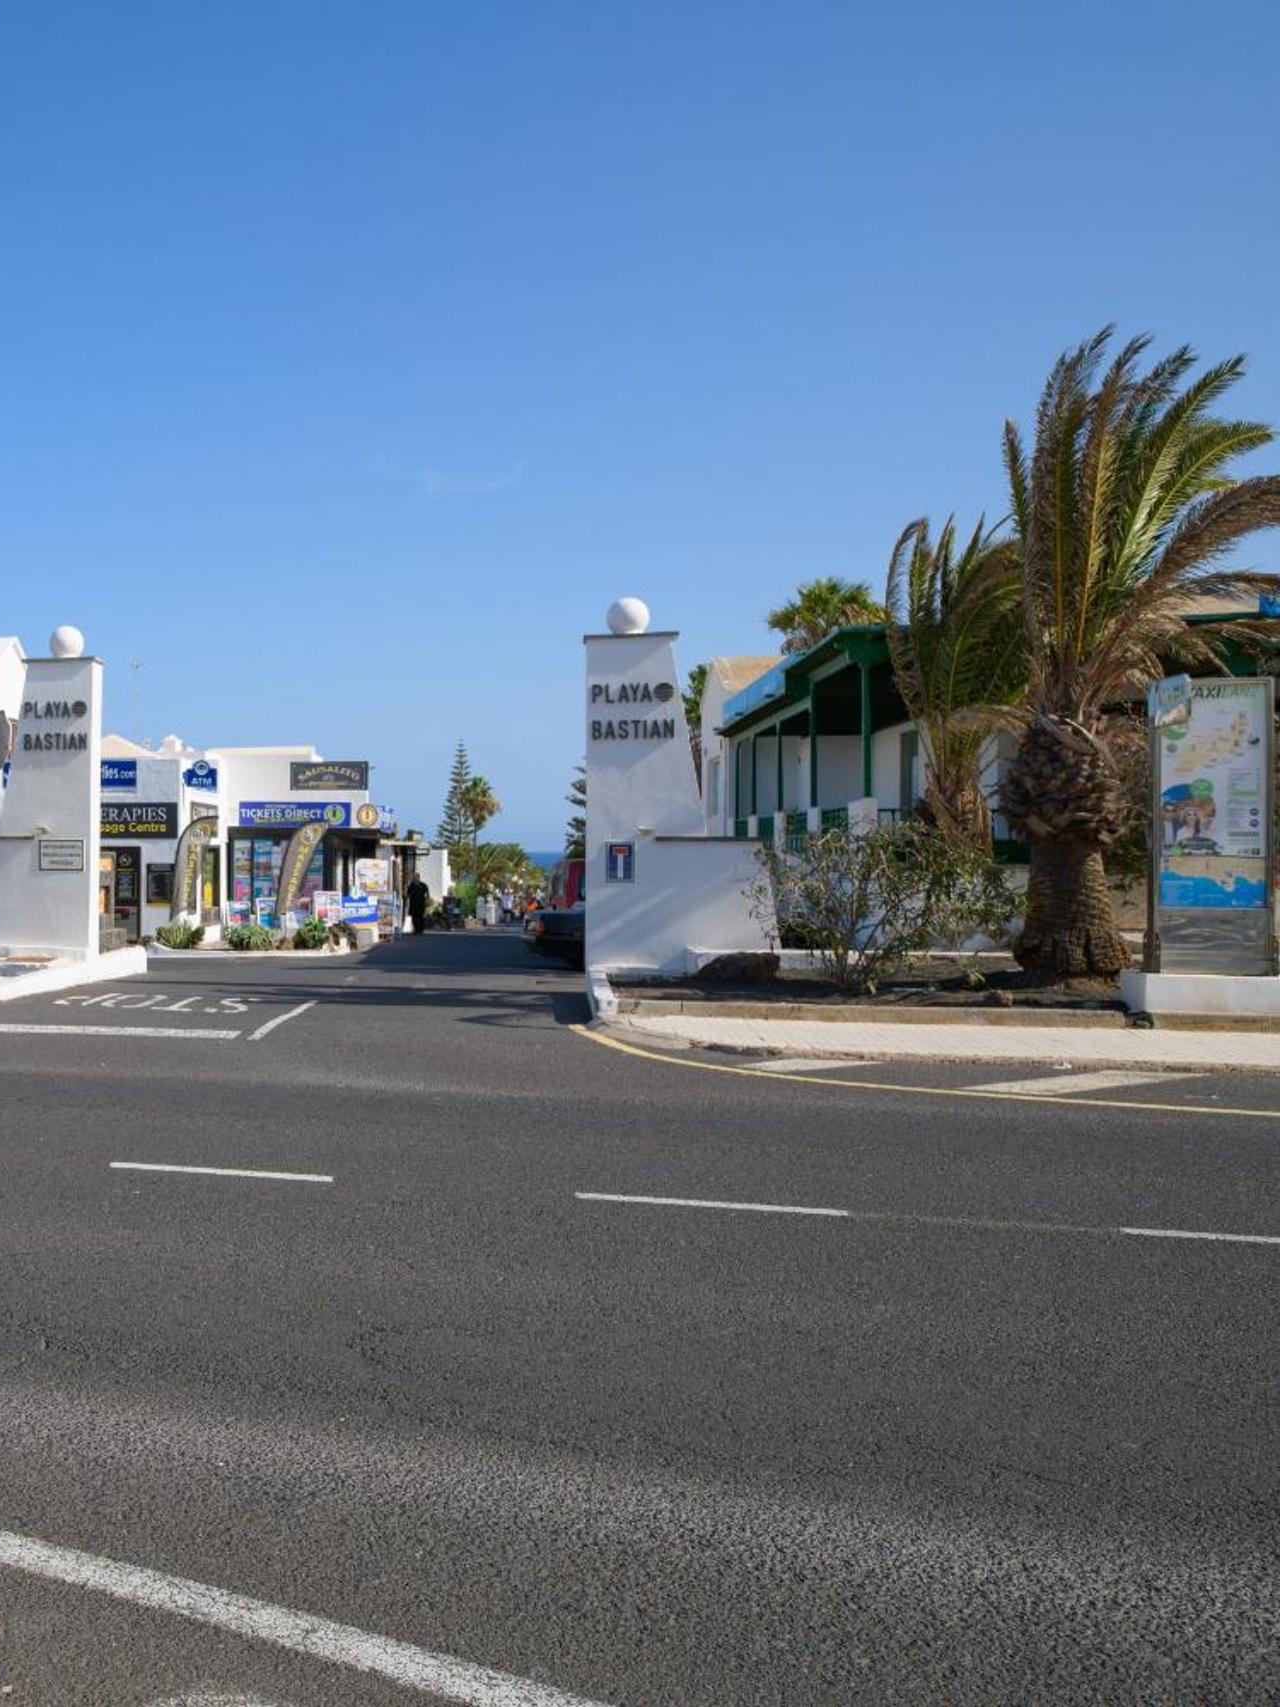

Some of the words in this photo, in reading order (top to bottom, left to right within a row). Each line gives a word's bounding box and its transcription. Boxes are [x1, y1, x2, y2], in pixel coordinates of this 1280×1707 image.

[592, 682, 652, 703] PLAYA
[23, 700, 71, 719] PLAYA
[592, 719, 675, 740] BASTIAN
[23, 732, 87, 751] BASTIAN
[190, 777, 213, 785] ATM
[100, 806, 167, 822] ERAPIES
[240, 808, 282, 818] TICKETS
[284, 808, 322, 819] DIRECT
[128, 822, 167, 833] Centre
